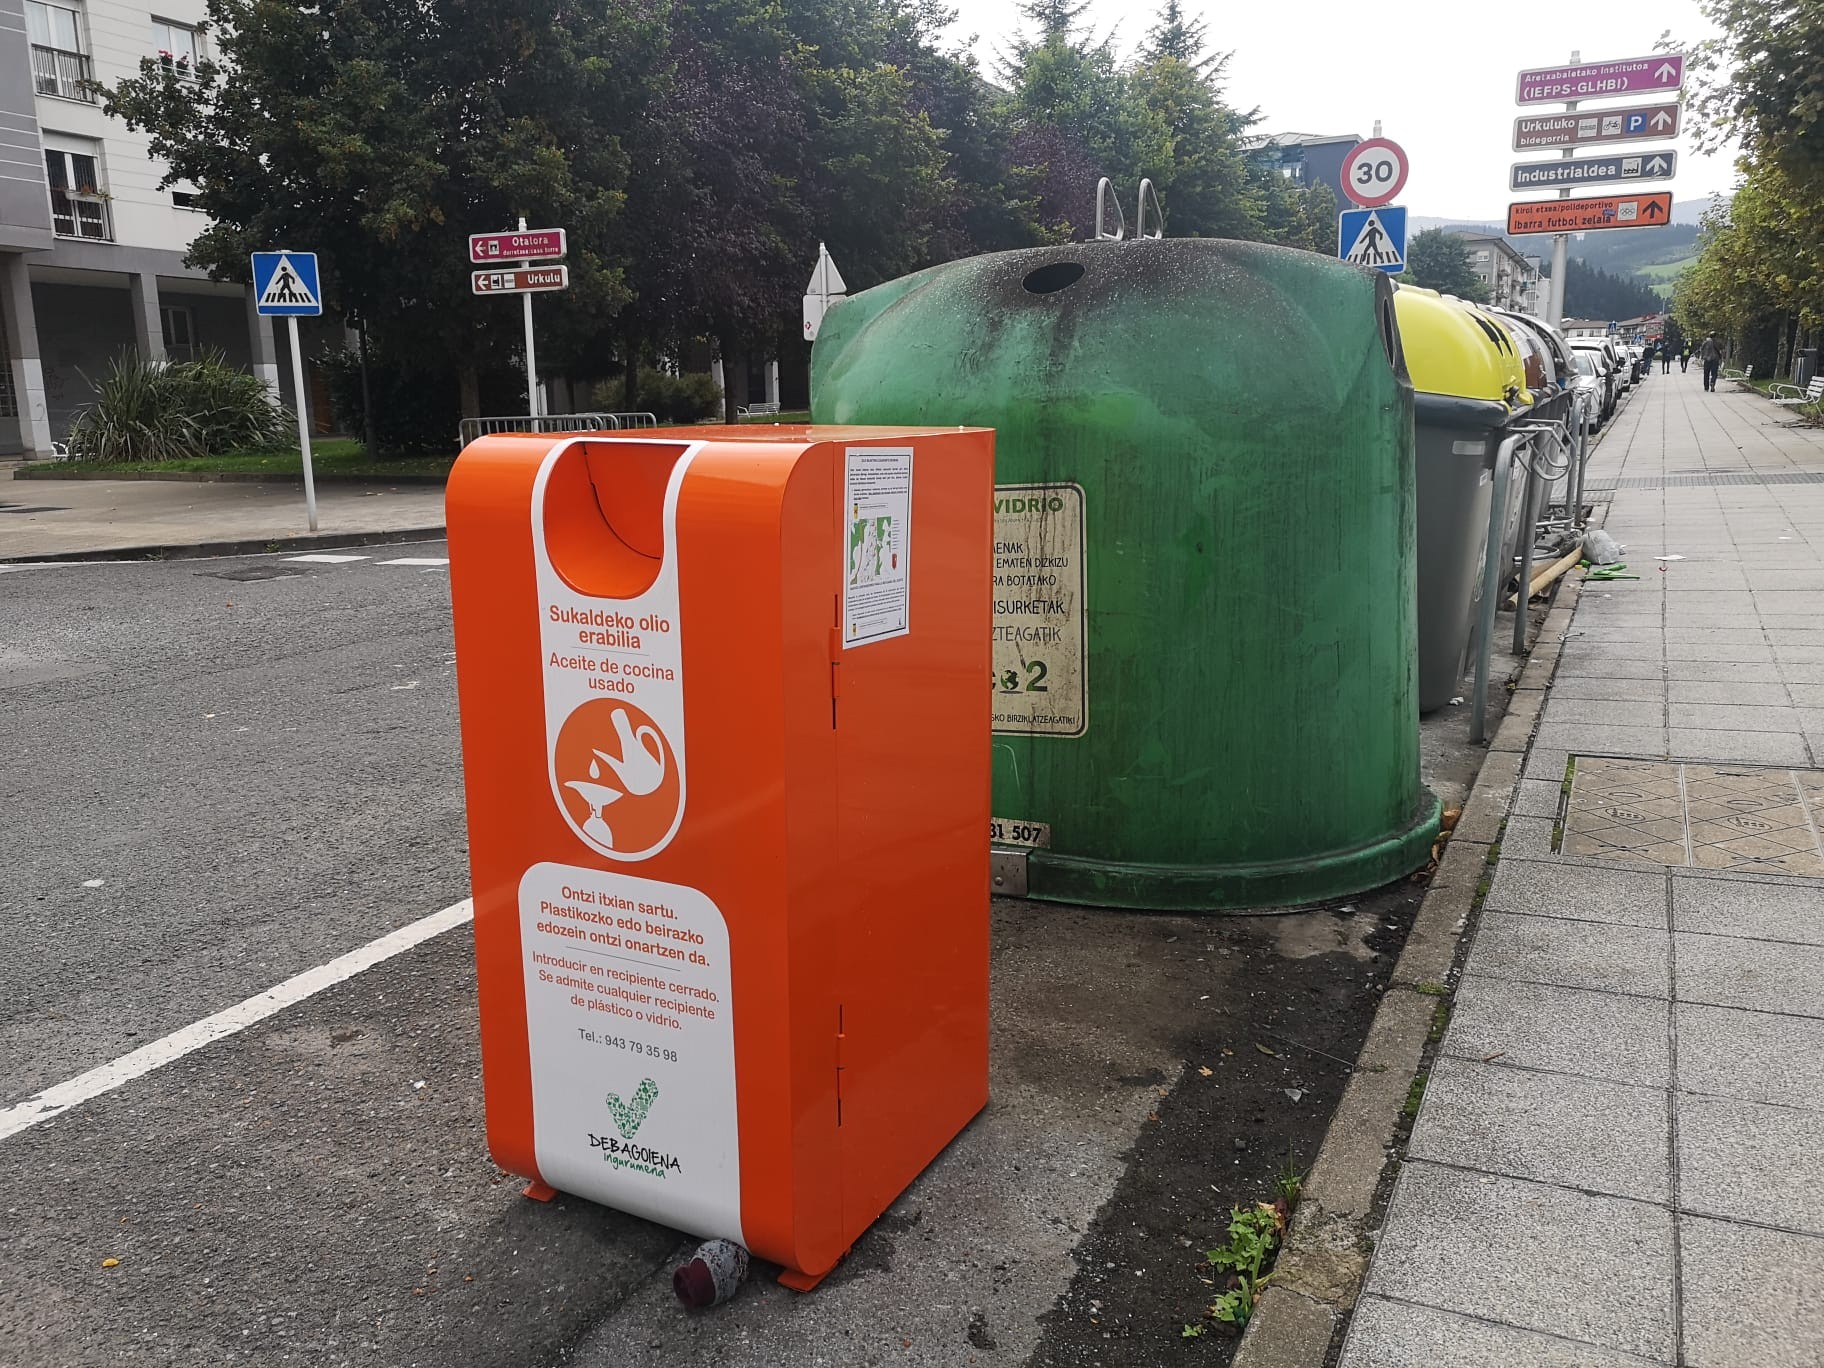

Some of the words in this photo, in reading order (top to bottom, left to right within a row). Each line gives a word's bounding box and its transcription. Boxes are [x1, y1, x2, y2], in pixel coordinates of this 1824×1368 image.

[1524, 77, 1628, 99] (IEFPS-GLHBI)
[1521, 118, 1575, 133] Urkuluko
[1629, 116, 1642, 131] P
[1520, 134, 1569, 146] bidegorria
[1357, 160, 1393, 185] 30
[1517, 164, 1616, 183] industrialdea
[1548, 216, 1577, 227] futbol
[1582, 214, 1611, 226] zelaia
[512, 236, 549, 247] Otalora
[527, 272, 560, 284] Urkulu
[994, 497, 1064, 514] VIDRIO
[996, 557, 1032, 568] EMATEN
[1034, 557, 1069, 568] DIZKIZU
[1006, 574, 1057, 586] BOTATAKO
[993, 600, 1065, 615] ISURKETAK
[549, 604, 634, 630] Sukaldeko
[639, 614, 670, 633] olio
[579, 629, 640, 649] erabilia
[550, 652, 596, 671] Aceite
[600, 658, 619, 674] de
[623, 663, 674, 681] cocina
[588, 677, 634, 694] usado
[1012, 825, 1042, 842] 507
[561, 886, 595, 904] Ontzi
[598, 892, 635, 911] itxian
[638, 902, 678, 920] sartu.
[540, 901, 613, 926] Plastikozko
[616, 917, 641, 932] edo
[645, 920, 704, 945] beirazko
[537, 921, 586, 940] edozein
[589, 931, 622, 947] ontzi
[625, 939, 685, 962] onartzen
[688, 951, 711, 966] da.
[532, 951, 587, 972] Introducir
[589, 964, 604, 977] en
[606, 968, 666, 990] recipiente
[669, 982, 720, 1003] cerrado.
[538, 969, 553, 983] Se
[555, 975, 594, 991] admite
[596, 984, 652, 1004] cualquier
[654, 996, 715, 1020] recipiente
[570, 994, 584, 1007] de
[587, 998, 633, 1018] plástico
[635, 1010, 644, 1020] o
[645, 1011, 682, 1030] vidrio.
[578, 1028, 602, 1044] Tel.:
[604, 1035, 626, 1050] 943
[629, 1041, 643, 1054] 79
[645, 1044, 661, 1058] 35
[663, 1049, 678, 1063] 98
[587, 1133, 682, 1174] DEBAGOIENA
